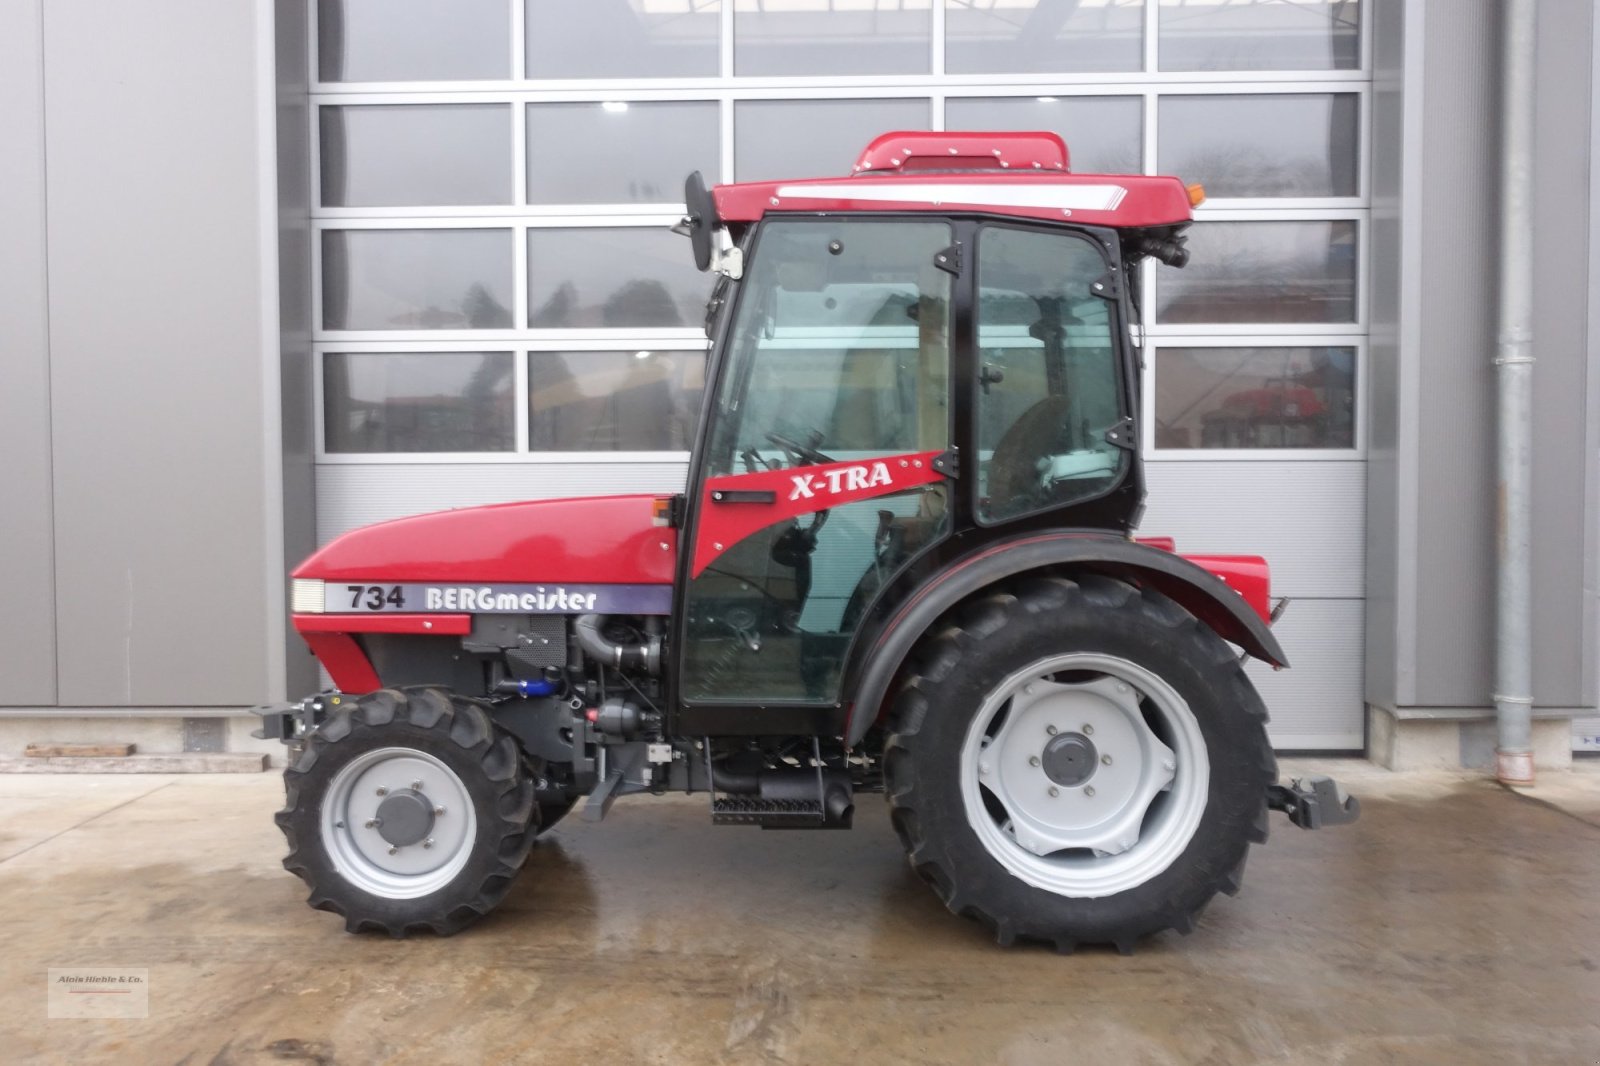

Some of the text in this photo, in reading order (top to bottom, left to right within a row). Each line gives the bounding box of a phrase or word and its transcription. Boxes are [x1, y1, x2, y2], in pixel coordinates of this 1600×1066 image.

[789, 462, 893, 501] X-TRA
[347, 585, 597, 610] 734 BERGmeister
